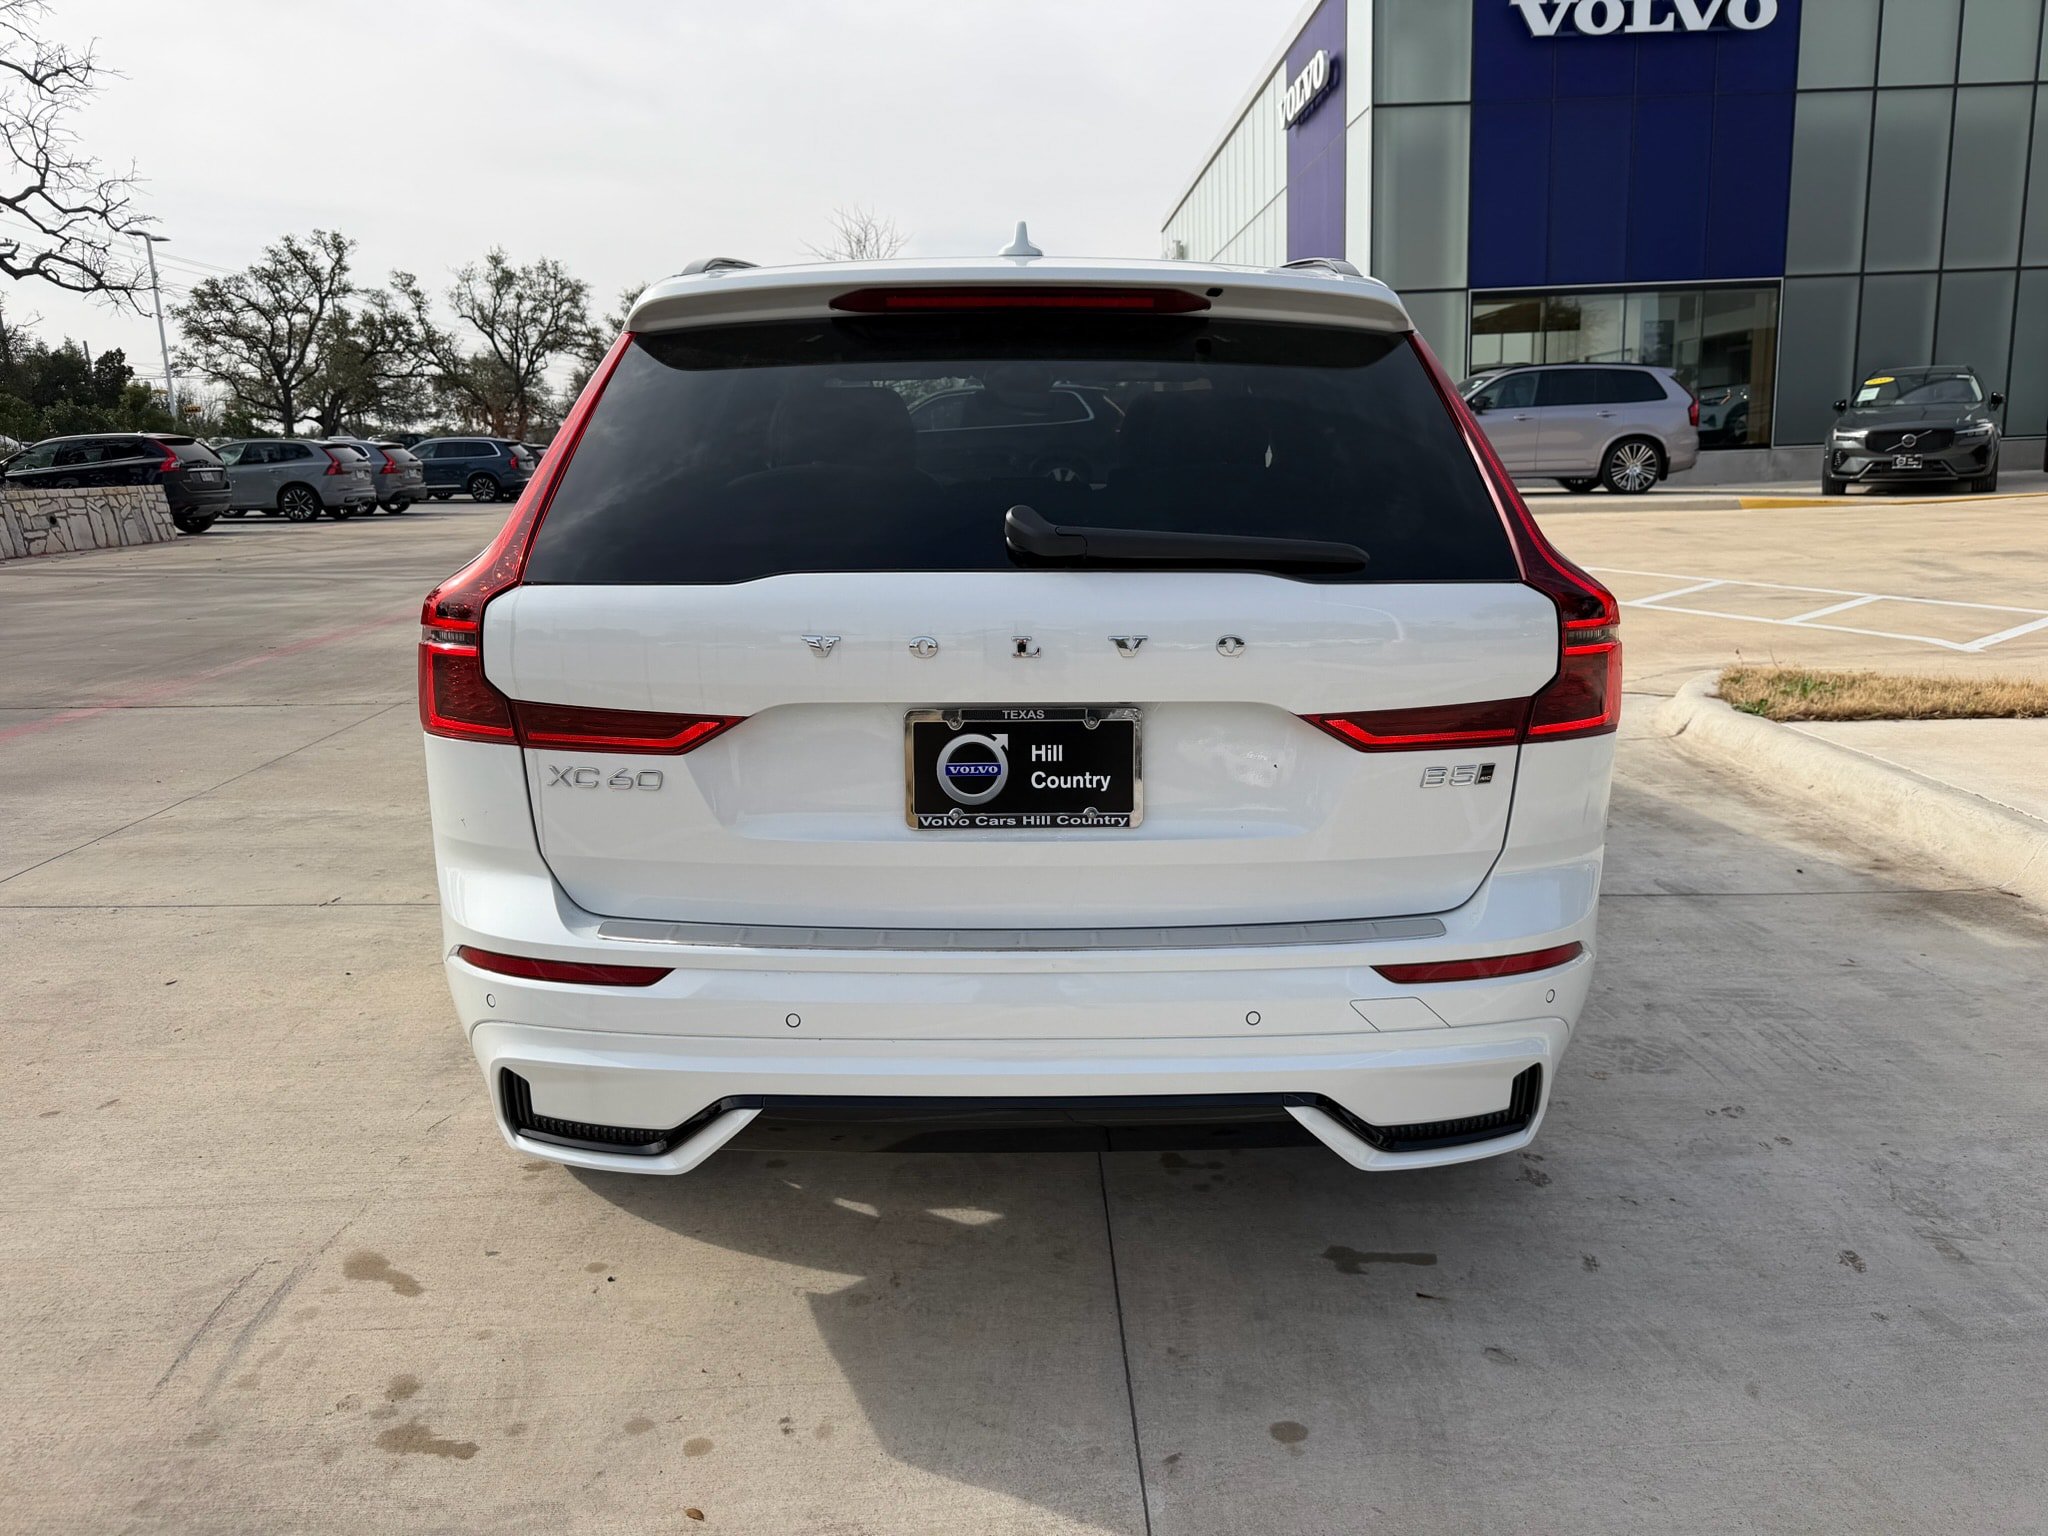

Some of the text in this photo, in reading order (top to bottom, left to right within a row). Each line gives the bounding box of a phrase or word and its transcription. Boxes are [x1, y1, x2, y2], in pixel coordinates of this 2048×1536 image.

[1509, 0, 1778, 37] VOLVO
[1278, 50, 1329, 130] VOLVO
[1002, 709, 1045, 720] TEXAS
[1031, 744, 1063, 762] Hill
[547, 765, 664, 791] XC60
[948, 765, 999, 775] VOLVO
[1420, 765, 1477, 788] B5
[1030, 771, 1111, 792] Country
[919, 815, 1129, 827] Volvo Cars Hill Country
